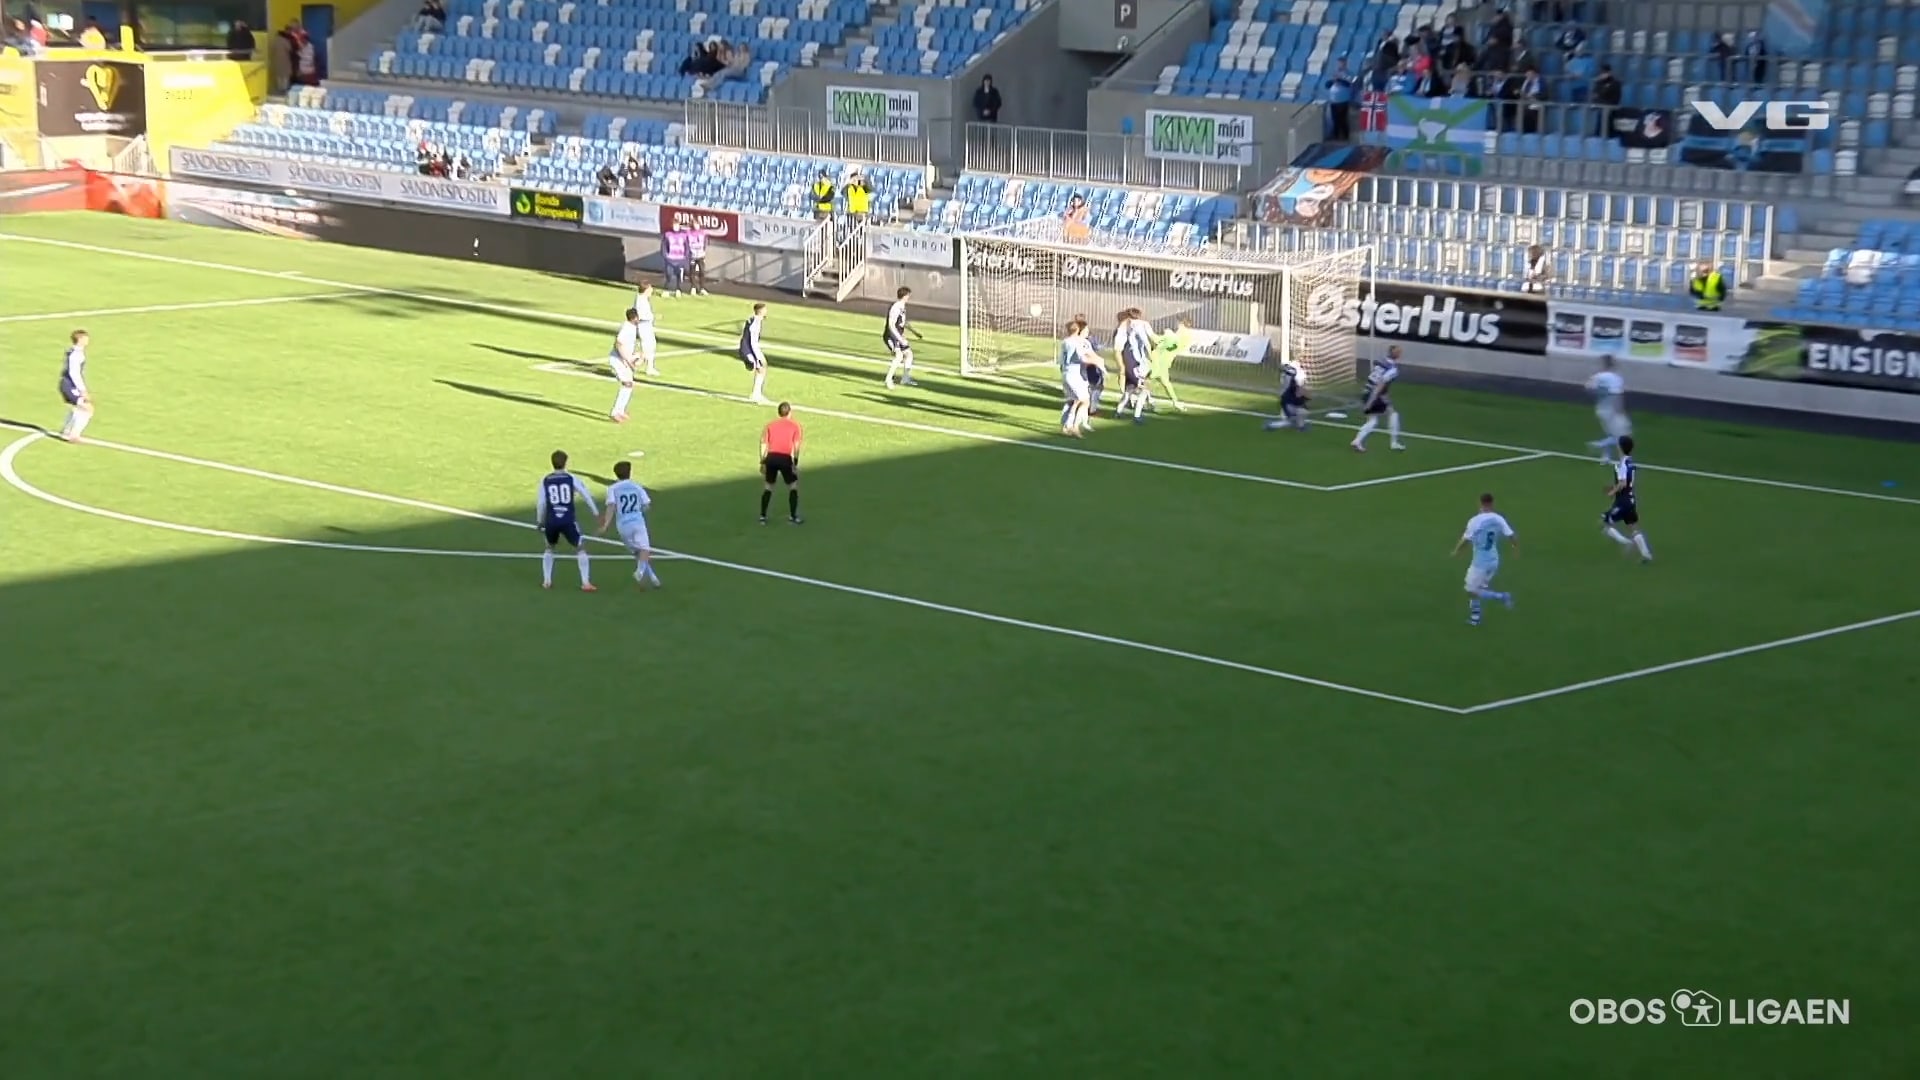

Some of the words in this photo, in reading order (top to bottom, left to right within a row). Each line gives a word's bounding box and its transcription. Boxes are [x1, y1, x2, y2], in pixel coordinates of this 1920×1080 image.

[833, 90, 886, 130] KIWI
[888, 94, 912, 112] mini
[1153, 114, 1215, 155] KIWI
[1217, 118, 1244, 138] mini
[400, 179, 498, 207] SANDNESPOSTEN
[548, 483, 571, 504] 80
[620, 493, 638, 514] 22
